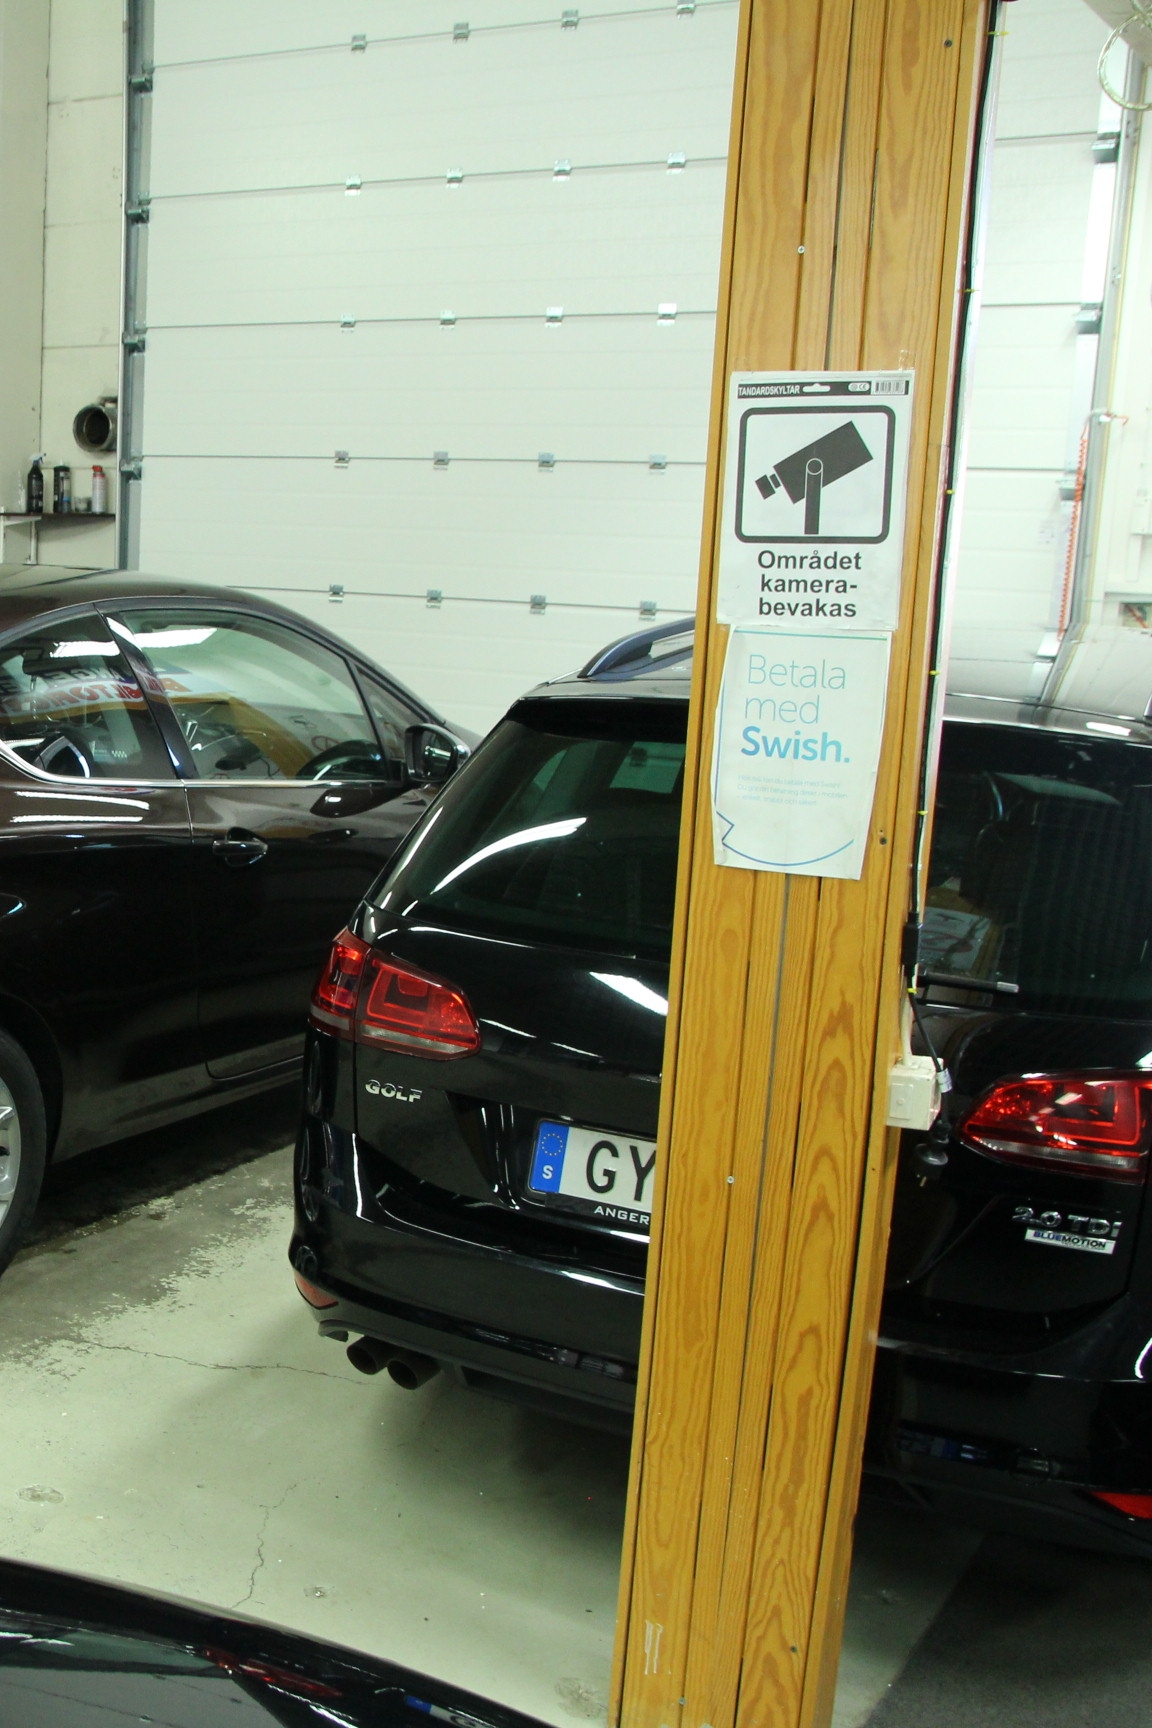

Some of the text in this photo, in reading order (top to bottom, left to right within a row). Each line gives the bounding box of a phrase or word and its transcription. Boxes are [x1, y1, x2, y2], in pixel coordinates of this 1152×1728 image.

[757, 549, 862, 570] Området
[760, 573, 858, 594] kamera-
[758, 597, 857, 618] bevakas
[748, 654, 846, 690] Betala
[744, 694, 820, 725] med
[740, 725, 851, 764] Swish.
[365, 1079, 423, 1103] GOLF
[542, 1140, 656, 1203] S GY
[1033, 1229, 1106, 1249] BLUEMOTION
